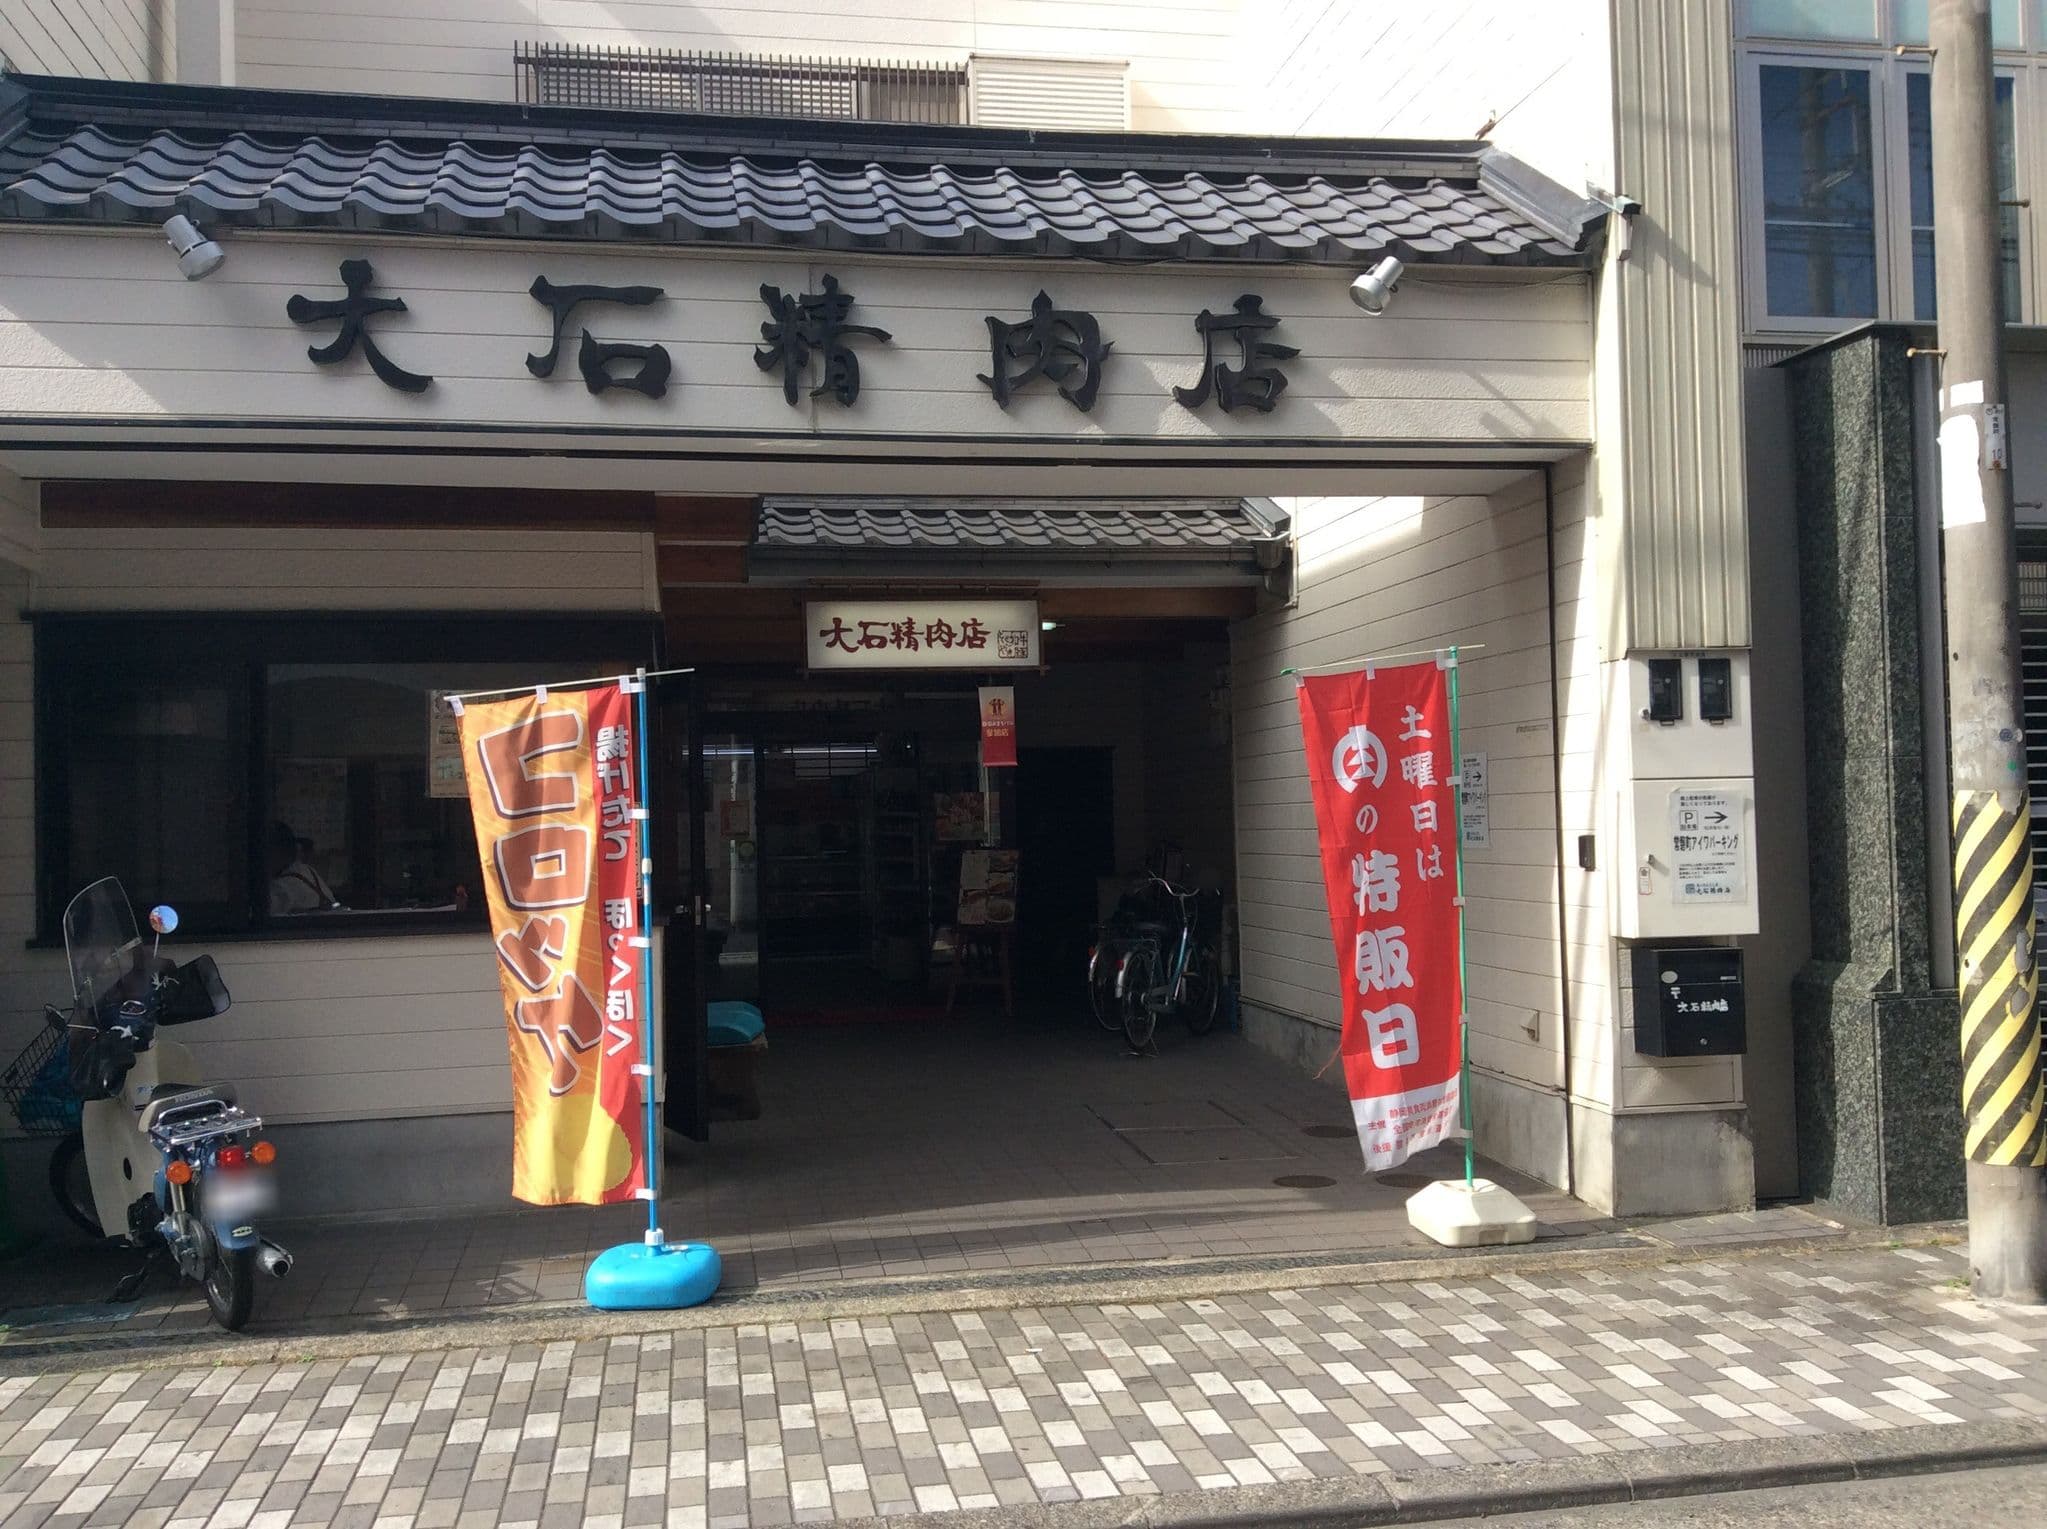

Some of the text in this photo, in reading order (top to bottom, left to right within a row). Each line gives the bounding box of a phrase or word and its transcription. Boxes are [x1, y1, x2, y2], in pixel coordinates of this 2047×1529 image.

[286, 259, 1302, 414] 大石精肉店
[819, 616, 991, 654] 大石精肉店
[1398, 704, 1445, 882] 土曜日は
[1684, 812, 1693, 824] P
